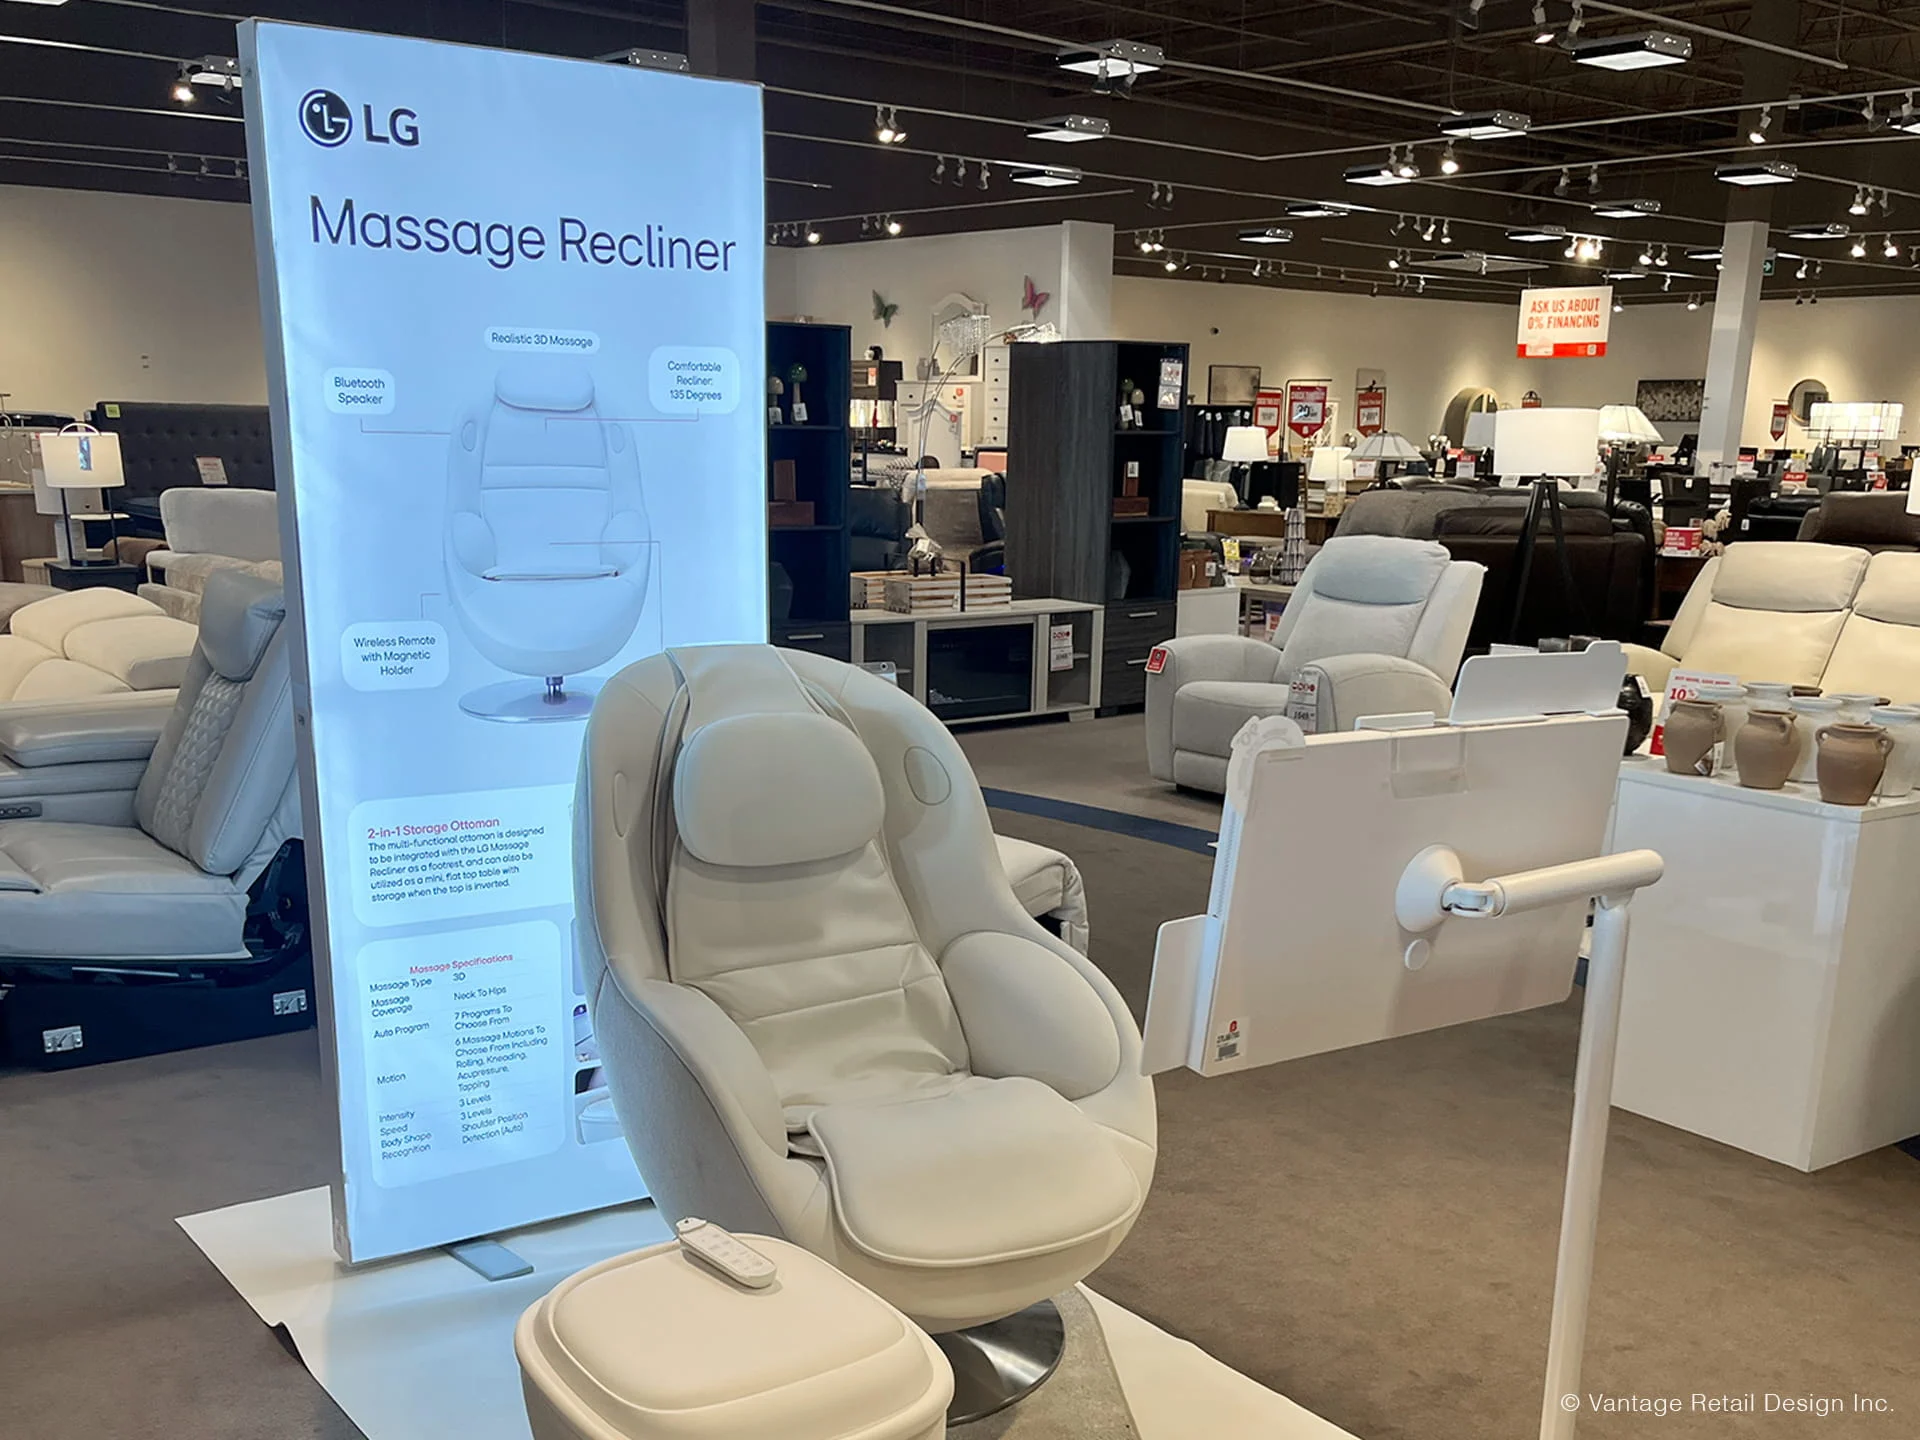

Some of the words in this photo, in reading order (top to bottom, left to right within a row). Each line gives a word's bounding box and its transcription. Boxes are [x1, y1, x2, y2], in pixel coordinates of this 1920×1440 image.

[363, 104, 419, 147] LG
[310, 195, 546, 269] Massage
[559, 217, 736, 271] Recliner
[1531, 300, 1549, 313] ASK
[1552, 300, 1565, 313] US
[1567, 298, 1600, 312] ABOUT
[1527, 316, 1544, 330] 0%
[1547, 314, 1600, 329] FINANCING
[491, 332, 532, 344] Realistic
[534, 334, 549, 345] 3D
[550, 335, 593, 348] Massage
[667, 360, 722, 372] Comfortable
[334, 376, 385, 388] Bluetooth
[338, 392, 383, 405] Speaker
[670, 389, 685, 400] 135
[686, 389, 722, 402] Degrees
[353, 637, 397, 648] Wireless
[398, 636, 436, 646] Remote
[361, 652, 382, 662] with
[384, 650, 431, 663] Magnetic
[380, 665, 414, 676] Holder
[368, 826, 400, 839] 2-in-1
[403, 823, 449, 836] Storage
[450, 818, 500, 831] Ottoman
[368, 842, 386, 852] The
[387, 835, 459, 850] multi-functional
[459, 832, 496, 843] ottoman
[497, 831, 504, 839] is
[505, 826, 544, 838] designed
[369, 856, 379, 865] to
[380, 855, 392, 863] be
[394, 849, 440, 862] integrated
[441, 847, 460, 857] with
[460, 846, 475, 855] the
[477, 843, 489, 853] LG
[490, 841, 529, 852] Massage
[369, 866, 406, 877] Recliner
[407, 865, 419, 873] as
[420, 864, 427, 872] a
[465, 857, 483, 867] and
[484, 856, 501, 865] can
[502, 853, 521, 863] also
[521, 852, 534, 861] be
[370, 878, 403, 890] utilized
[404, 878, 416, 886] as
[416, 877, 424, 885] a
[446, 872, 461, 881] flat
[462, 871, 477, 880] top
[479, 867, 501, 877] table
[502, 865, 520, 874] with
[371, 891, 406, 902] storage
[407, 888, 432, 898] when
[432, 886, 448, 895] the
[449, 885, 464, 894] top
[465, 883, 473, 891] is
[409, 963, 451, 975] Massage
[451, 954, 513, 969] Specifications
[452, 972, 466, 981] 3D
[369, 981, 409, 993] Massage
[411, 978, 433, 988] Type
[454, 990, 476, 1001] Neck
[477, 988, 488, 997] To
[489, 986, 507, 995] Hips
[371, 995, 410, 1008] Massage
[371, 1004, 413, 1017] Coverage
[461, 1007, 501, 1019] Programs
[502, 1005, 513, 1013] To
[373, 1030, 394, 1039] Auto
[394, 1022, 430, 1035] Program
[454, 1019, 488, 1030] Choose
[489, 1016, 510, 1025] From
[462, 1034, 501, 1045] Massage
[502, 1028, 534, 1039] Motions
[535, 1025, 546, 1033] To
[455, 1046, 488, 1057] Choose
[489, 1042, 511, 1052] From
[511, 1037, 548, 1049] Including
[377, 1073, 406, 1085] Motion
[458, 1080, 490, 1092] Tapping
[466, 1094, 492, 1106] Levels
[379, 1111, 415, 1123] Intensity
[467, 1107, 493, 1119] Levels
[380, 1123, 408, 1137] Speed
[461, 1118, 497, 1133] Shoulder
[498, 1112, 529, 1124] Position
[381, 1138, 403, 1149] Body
[404, 1132, 433, 1144] Shape
[462, 1129, 500, 1144] Detection
[381, 1144, 431, 1161] Recognition
